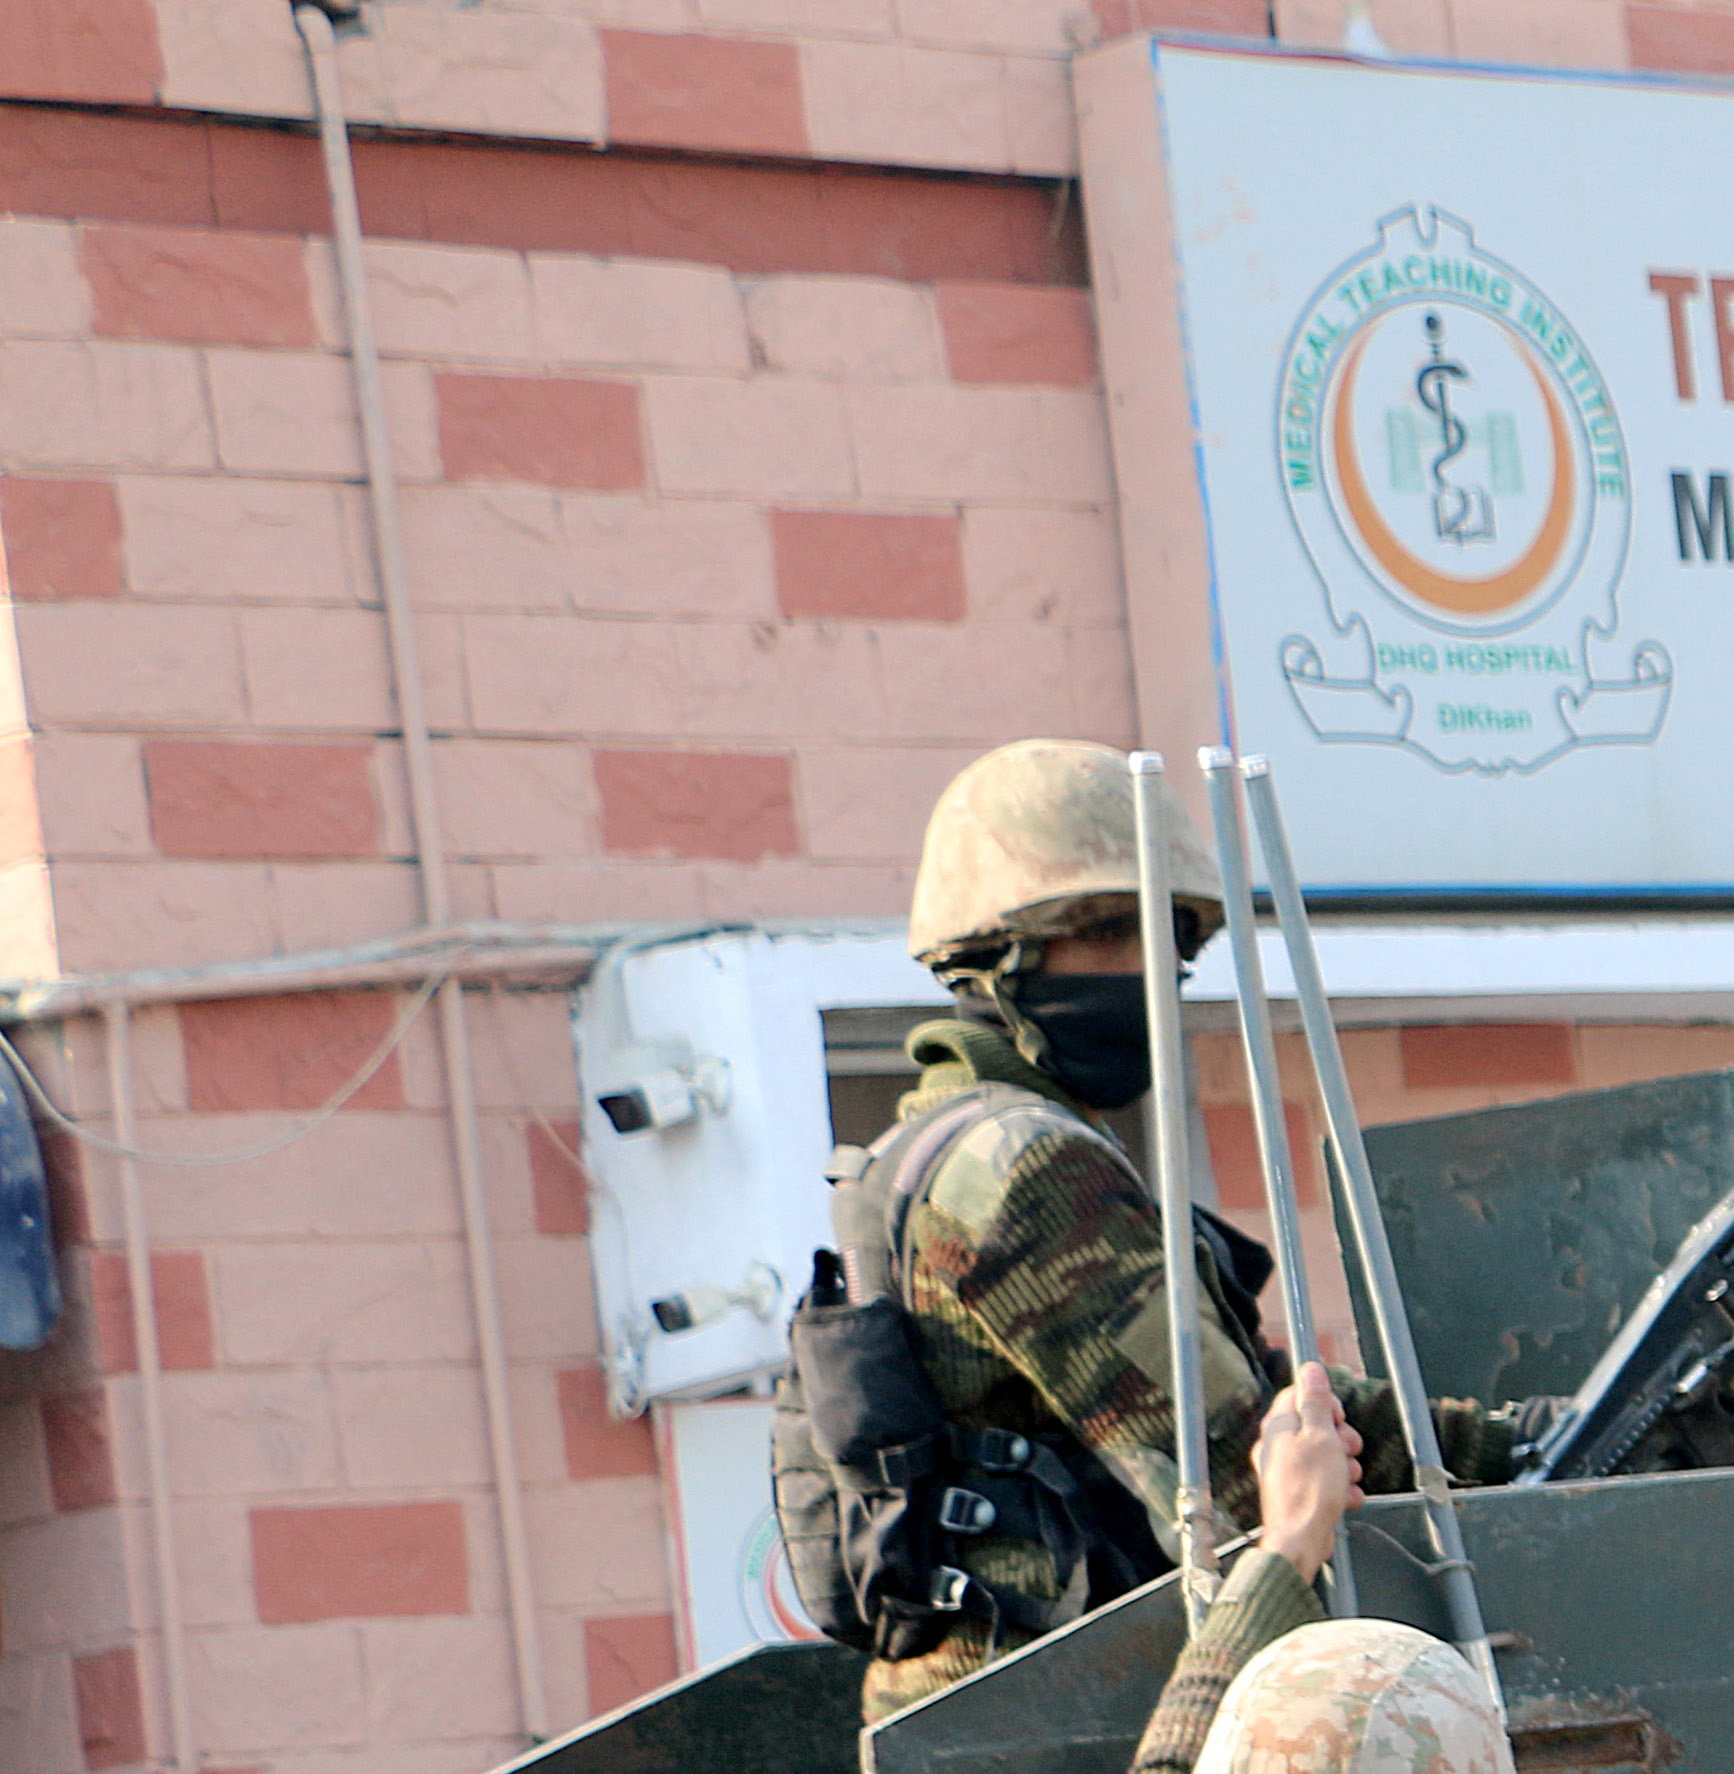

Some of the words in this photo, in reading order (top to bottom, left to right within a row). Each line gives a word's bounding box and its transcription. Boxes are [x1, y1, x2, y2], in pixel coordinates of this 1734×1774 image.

[1286, 313, 1344, 491] MEDICAL
[1337, 255, 1514, 314] TEACHING
[1520, 299, 1624, 498] INSTITUTE
[1377, 645, 1440, 673] DHQ
[1446, 645, 1577, 675] HOSPITAL
[1438, 704, 1533, 732] DIKhan
